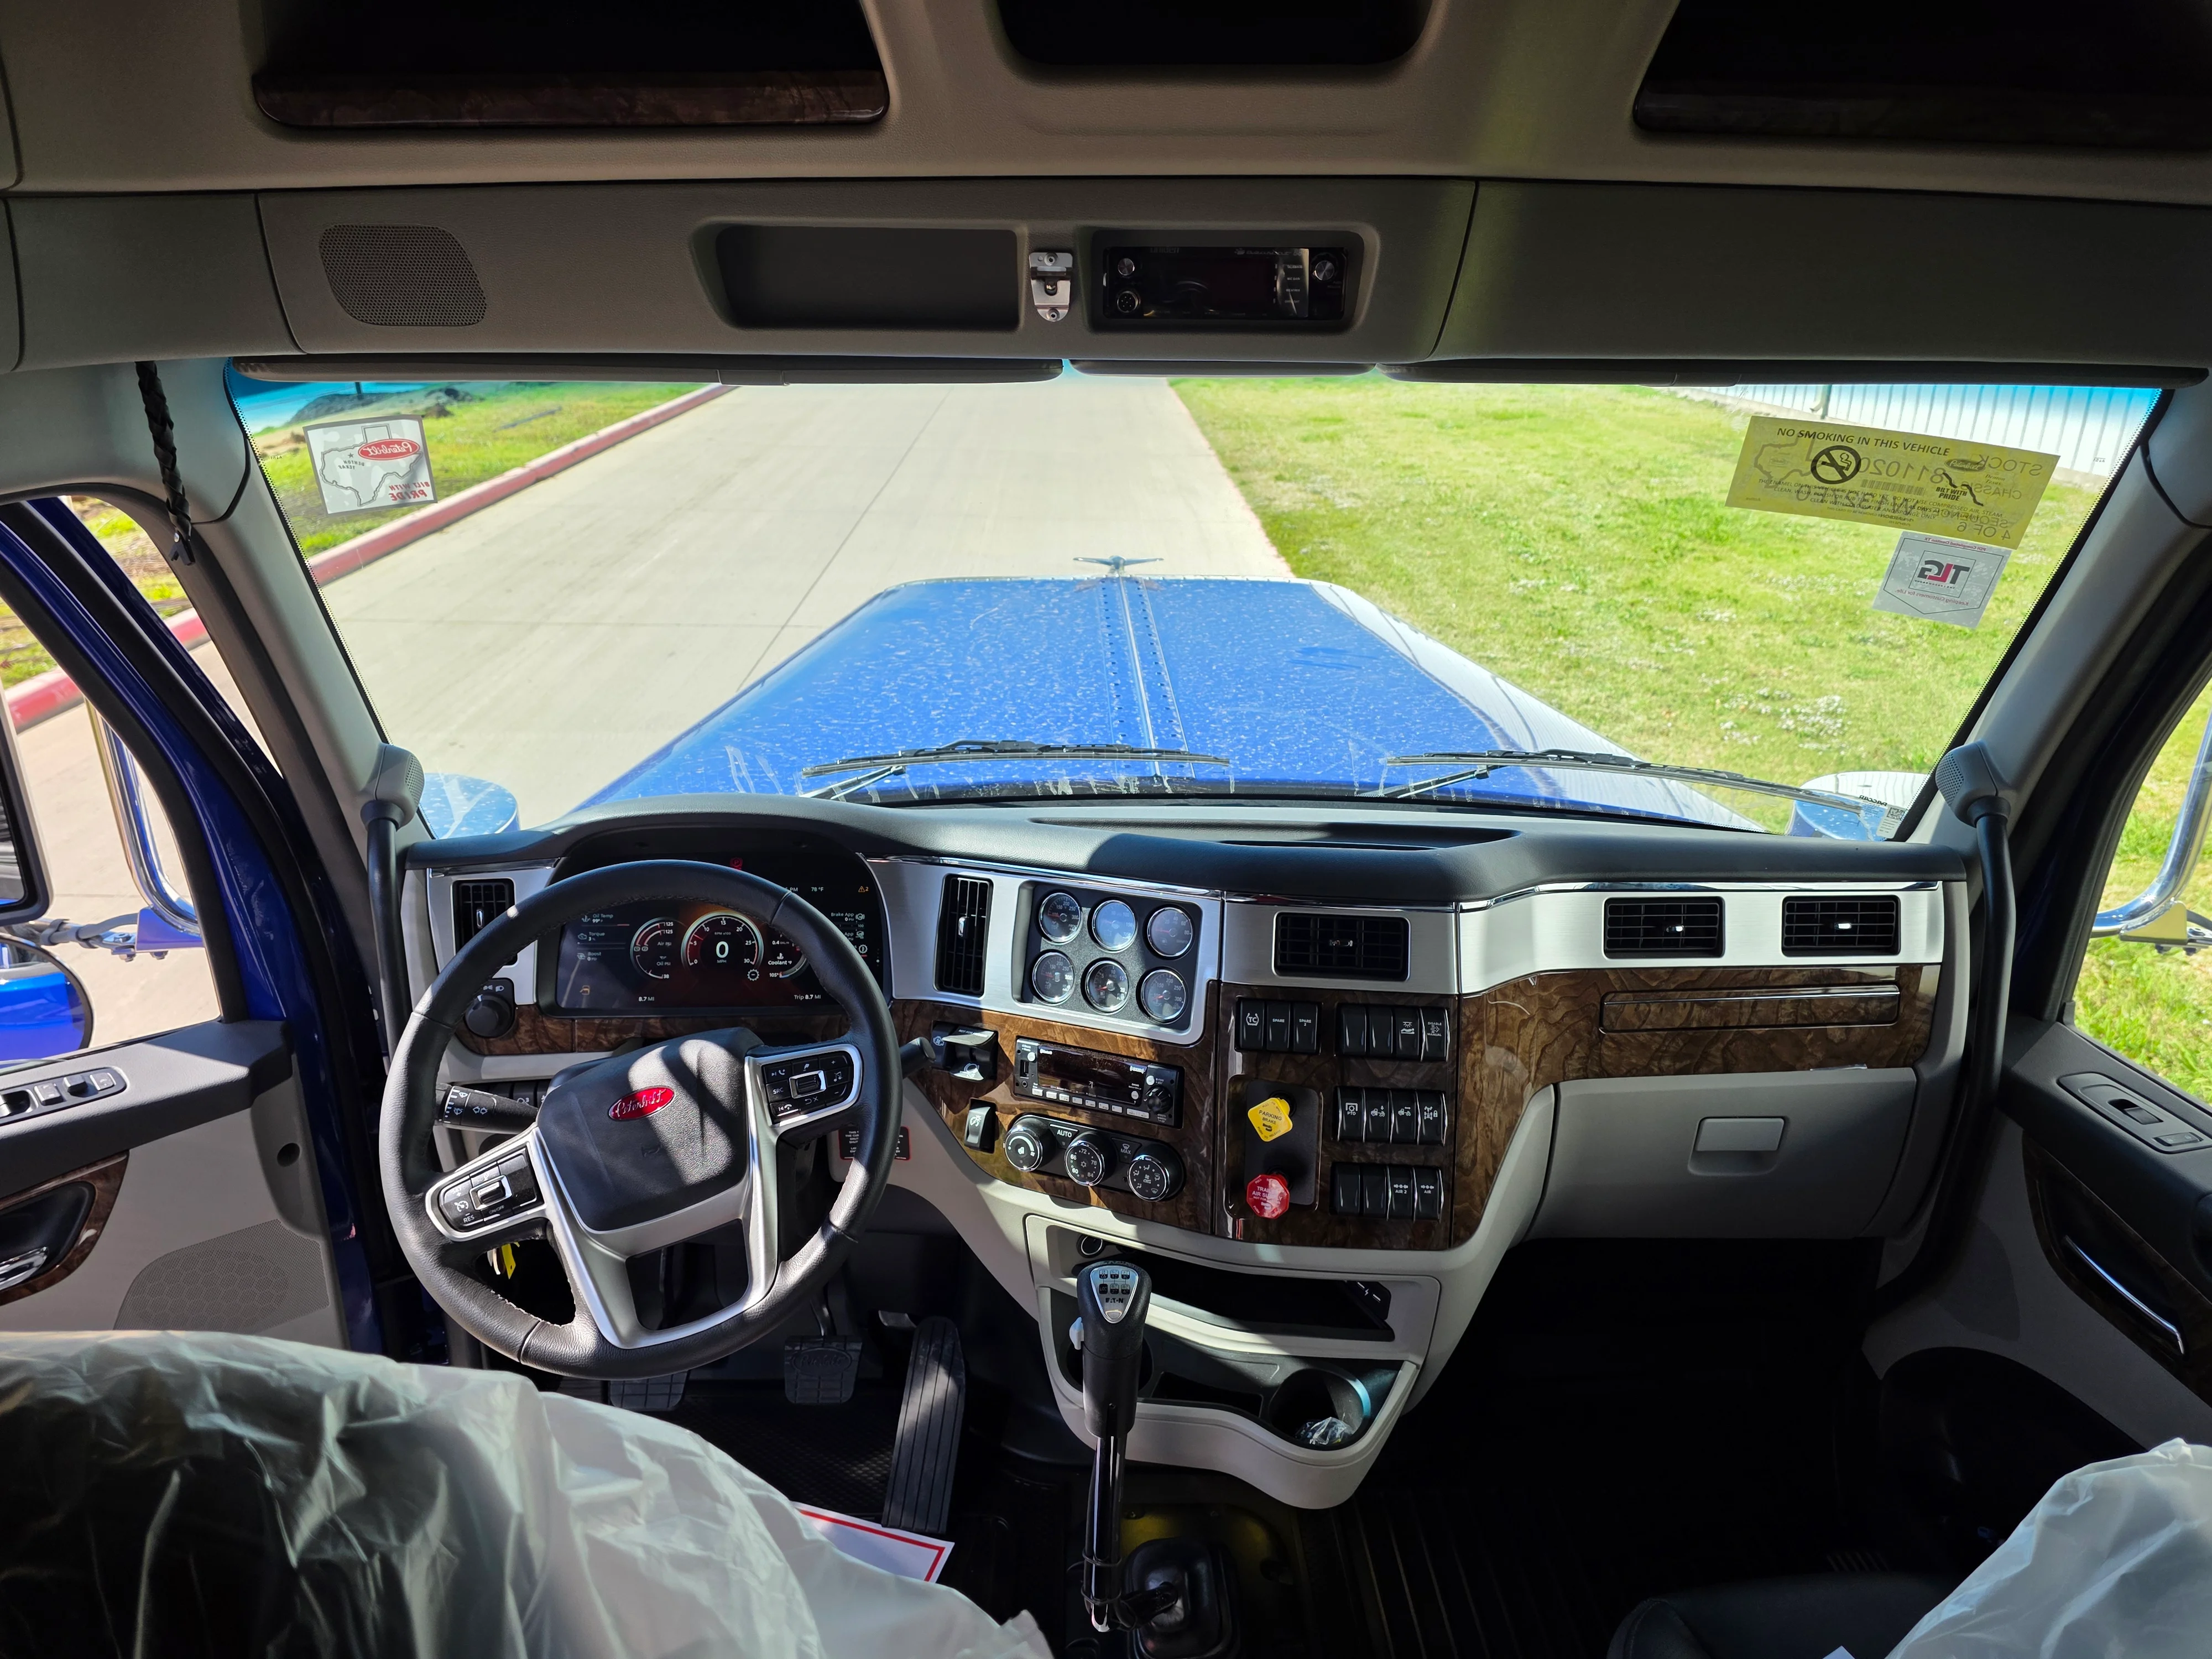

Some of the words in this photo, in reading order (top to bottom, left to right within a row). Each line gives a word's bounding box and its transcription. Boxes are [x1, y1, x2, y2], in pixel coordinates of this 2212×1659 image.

[1777, 428, 1795, 436] NO
[1797, 430, 1855, 444] SMOKING
[1857, 436, 1870, 445] IN
[1874, 438, 1899, 449] THIS
[1903, 442, 1950, 456] VEHICLE
[1938, 492, 1960, 501] PRIDE
[1928, 501, 1968, 512] COMPRESSED
[716, 941, 729, 958] 0
[615, 1088, 666, 1117] Peterbilt
[1259, 1110, 1282, 1121] PARKING
[1057, 1129, 1072, 1138] AUTO
[489, 1205, 505, 1214] ON/OFF
[463, 1214, 475, 1223] RES
